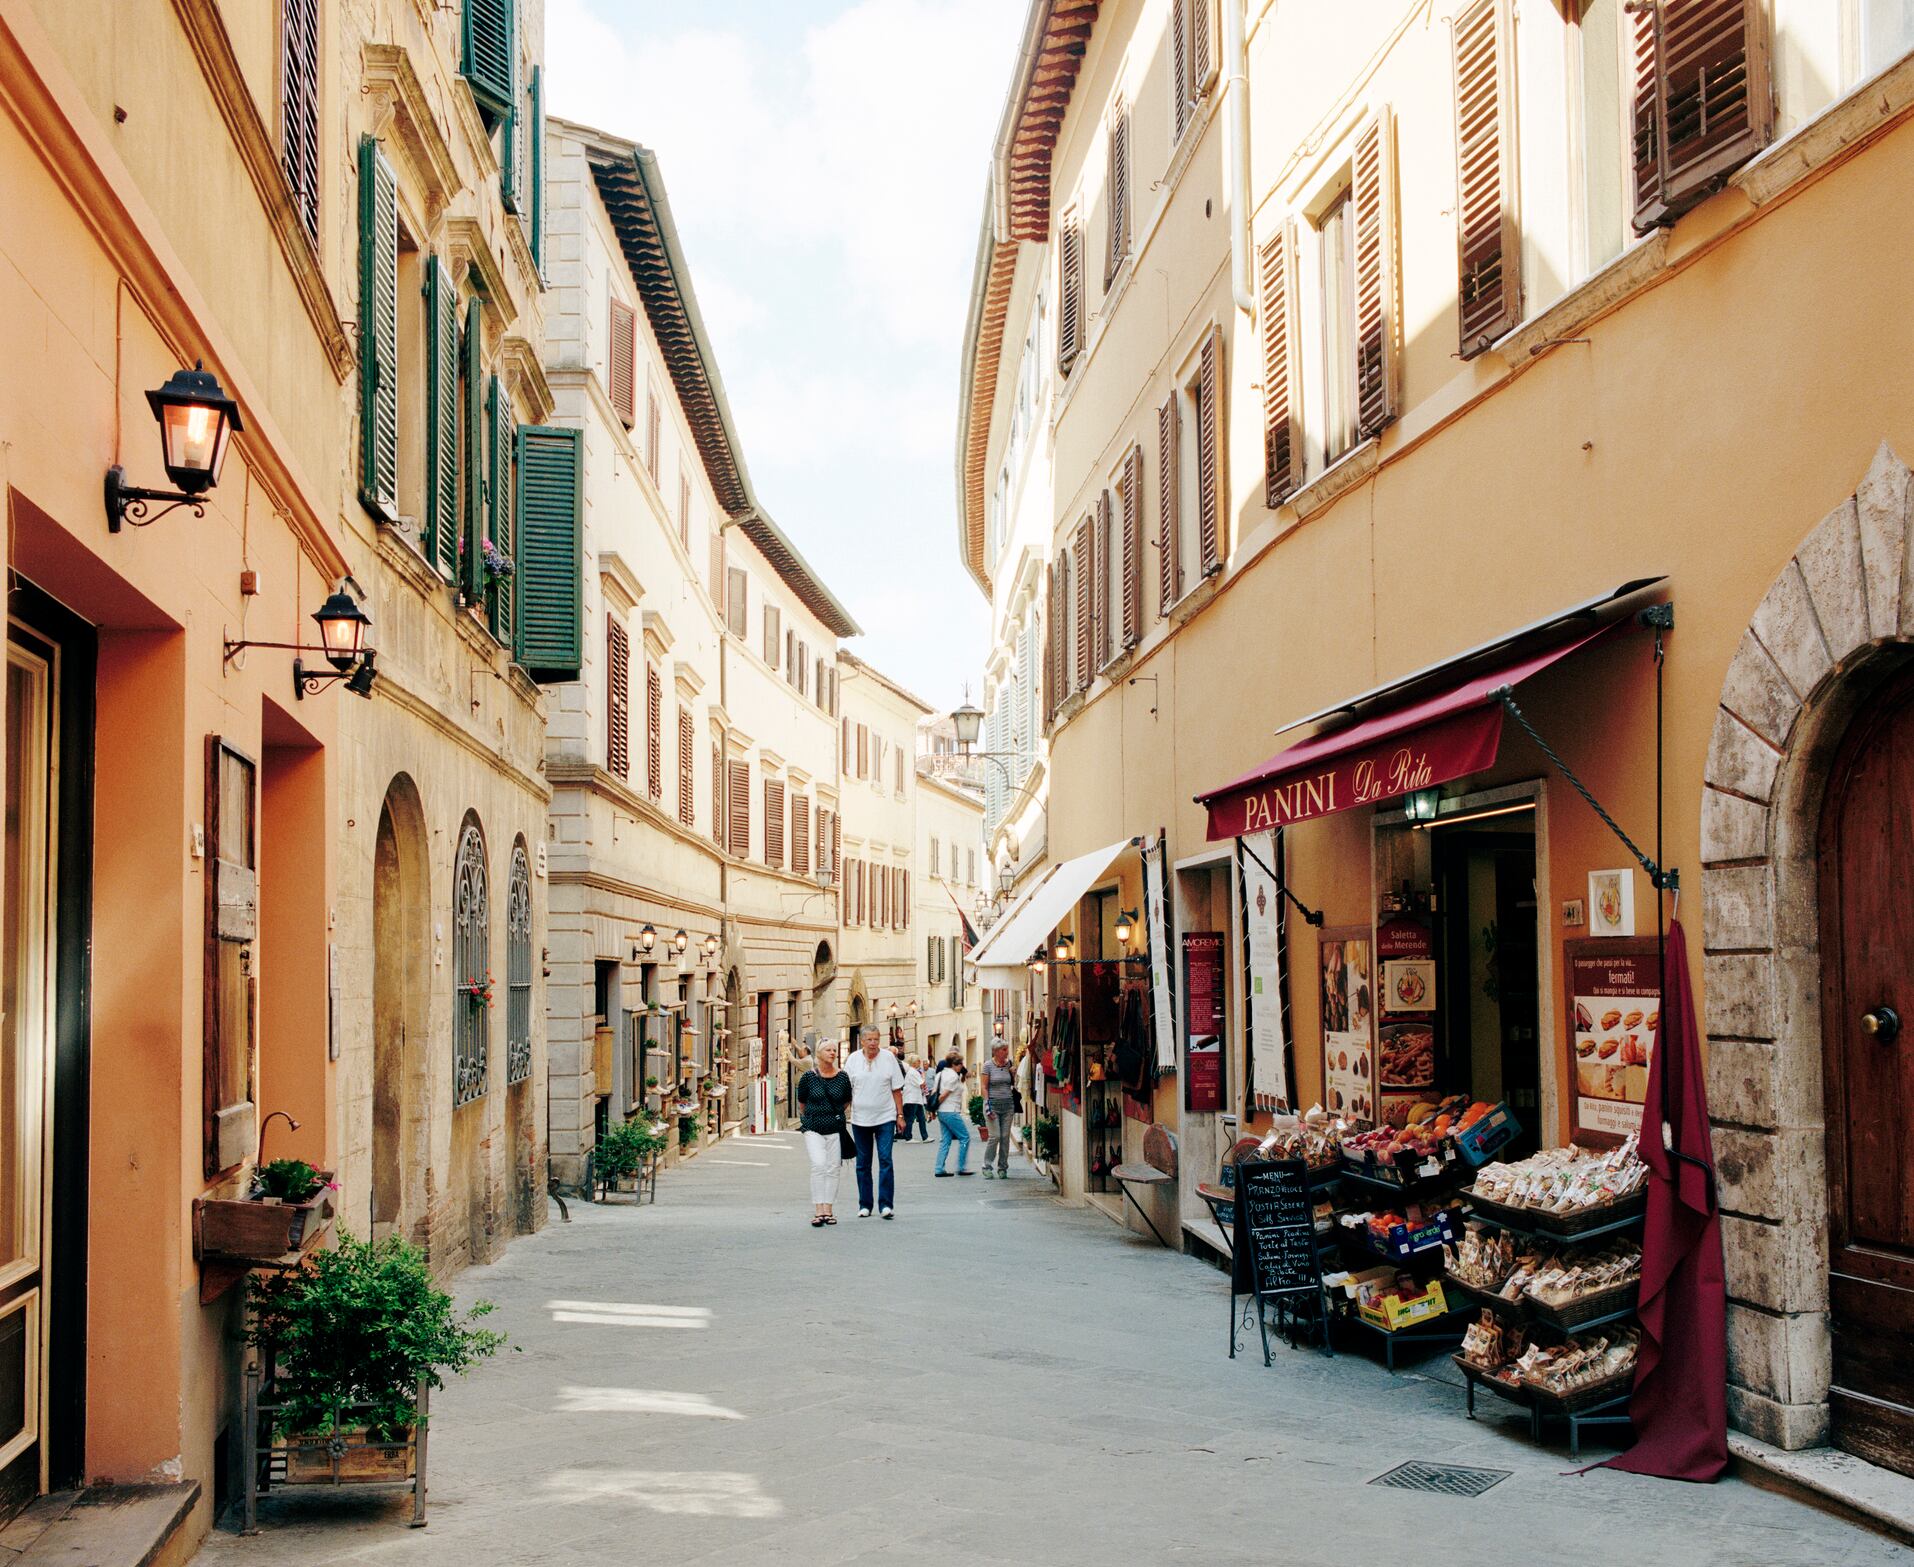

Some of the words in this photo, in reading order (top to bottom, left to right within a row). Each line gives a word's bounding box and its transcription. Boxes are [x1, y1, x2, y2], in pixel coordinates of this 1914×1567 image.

[1243, 771, 1337, 832] PANINI
[1352, 759, 1382, 803] Da
[1387, 747, 1432, 794] Rita
[1391, 930, 1417, 939] Saletta
[1394, 940, 1427, 949] Merende
[1620, 958, 1625, 967] la
[1608, 970, 1635, 984] fermati!
[1603, 987, 1618, 996] mangia
[1626, 987, 1635, 995] beve
[1599, 1103, 1613, 1113] panini
[1262, 1171, 1284, 1180] MENU
[1292, 1259, 1310, 1267] Vino
